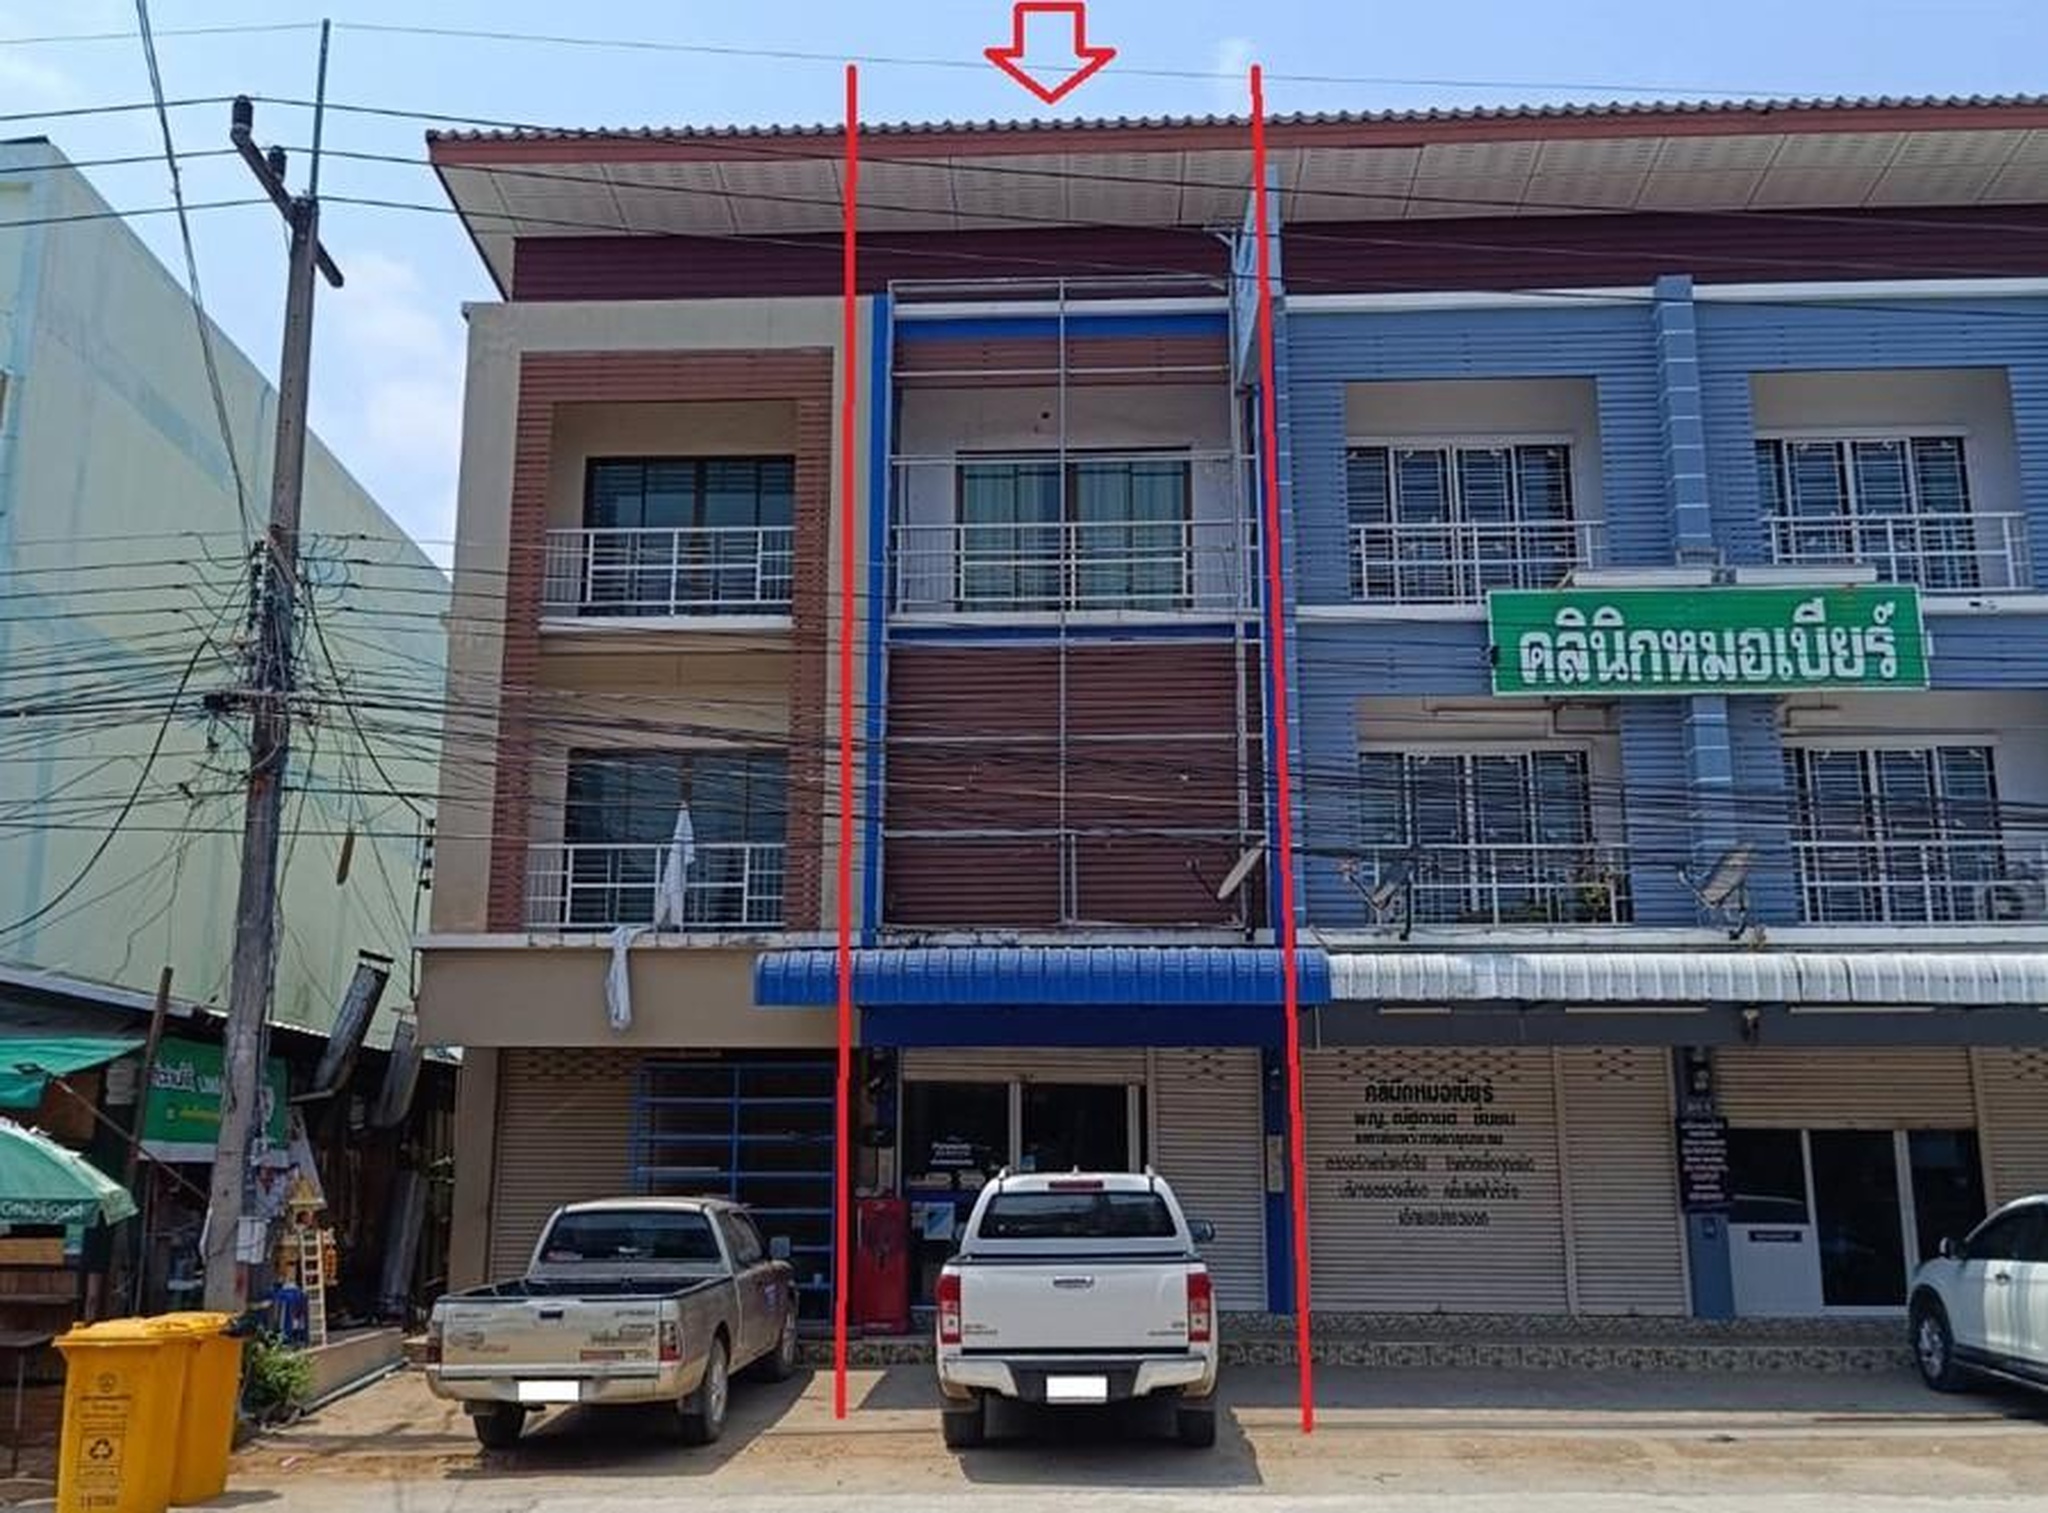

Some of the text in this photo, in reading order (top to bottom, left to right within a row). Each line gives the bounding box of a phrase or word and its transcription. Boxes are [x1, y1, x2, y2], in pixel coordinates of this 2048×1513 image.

[1519, 598, 1897, 683] คลินิกหมอเบียร์
